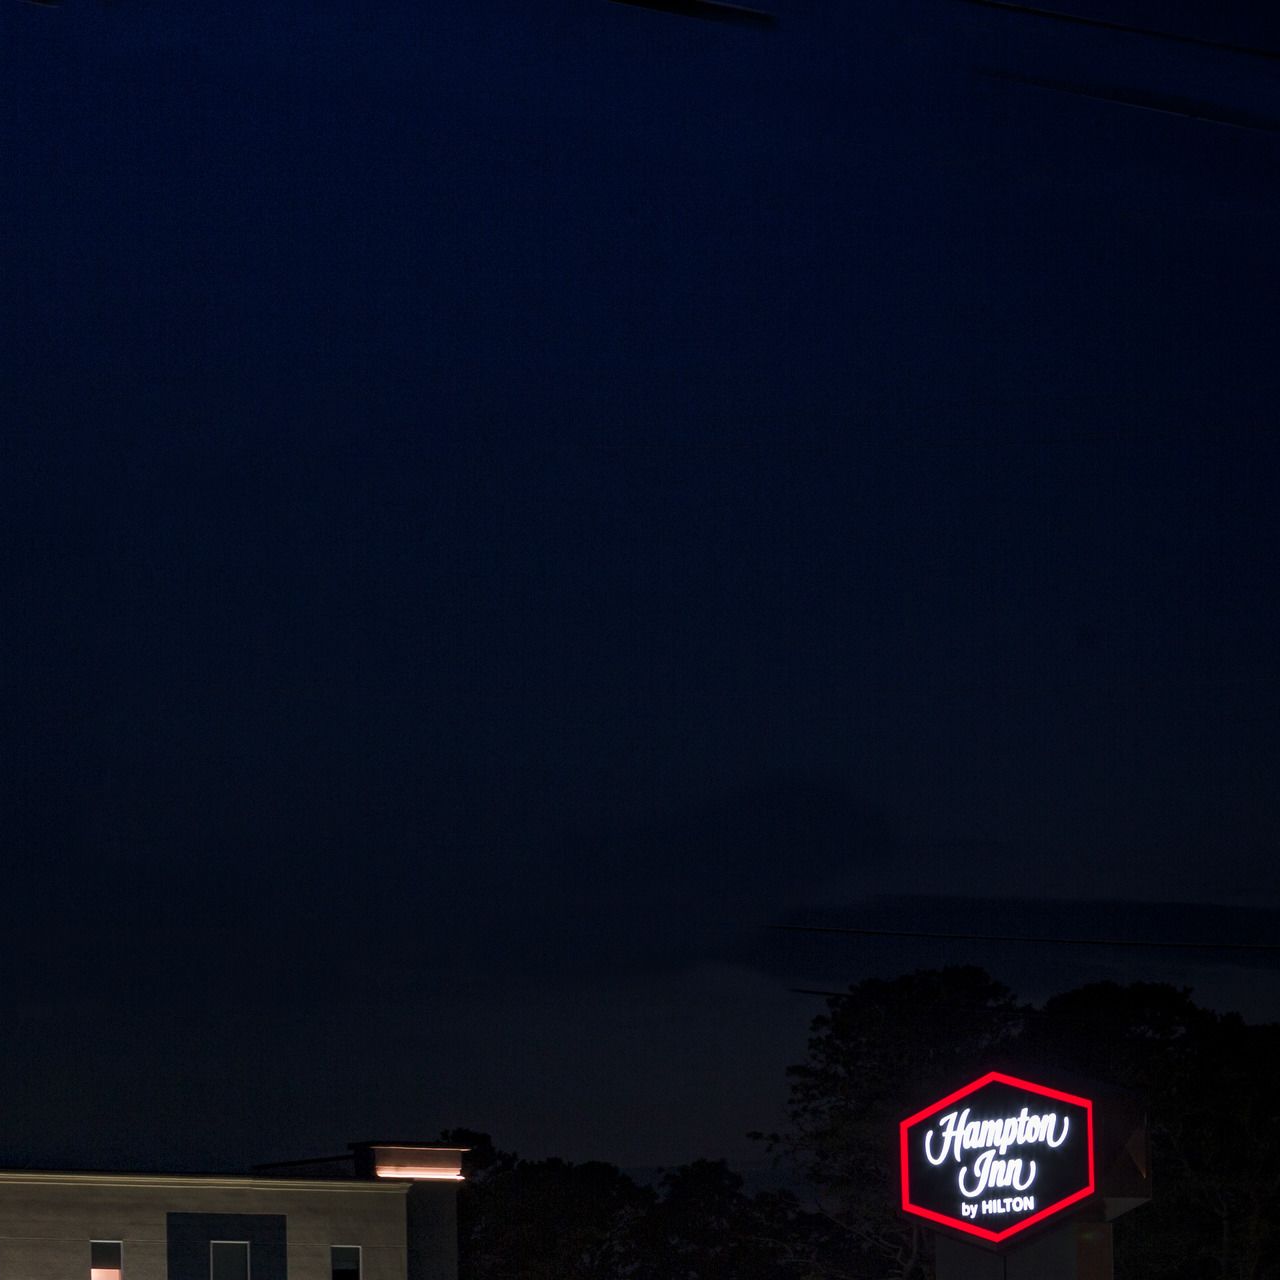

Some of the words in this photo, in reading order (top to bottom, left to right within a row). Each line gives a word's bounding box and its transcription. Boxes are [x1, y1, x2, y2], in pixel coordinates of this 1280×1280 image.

[924, 1107, 1070, 1166] Hampton
[958, 1149, 1036, 1198] Inn
[961, 1202, 978, 1219] by
[981, 1196, 1035, 1215] HILTON
